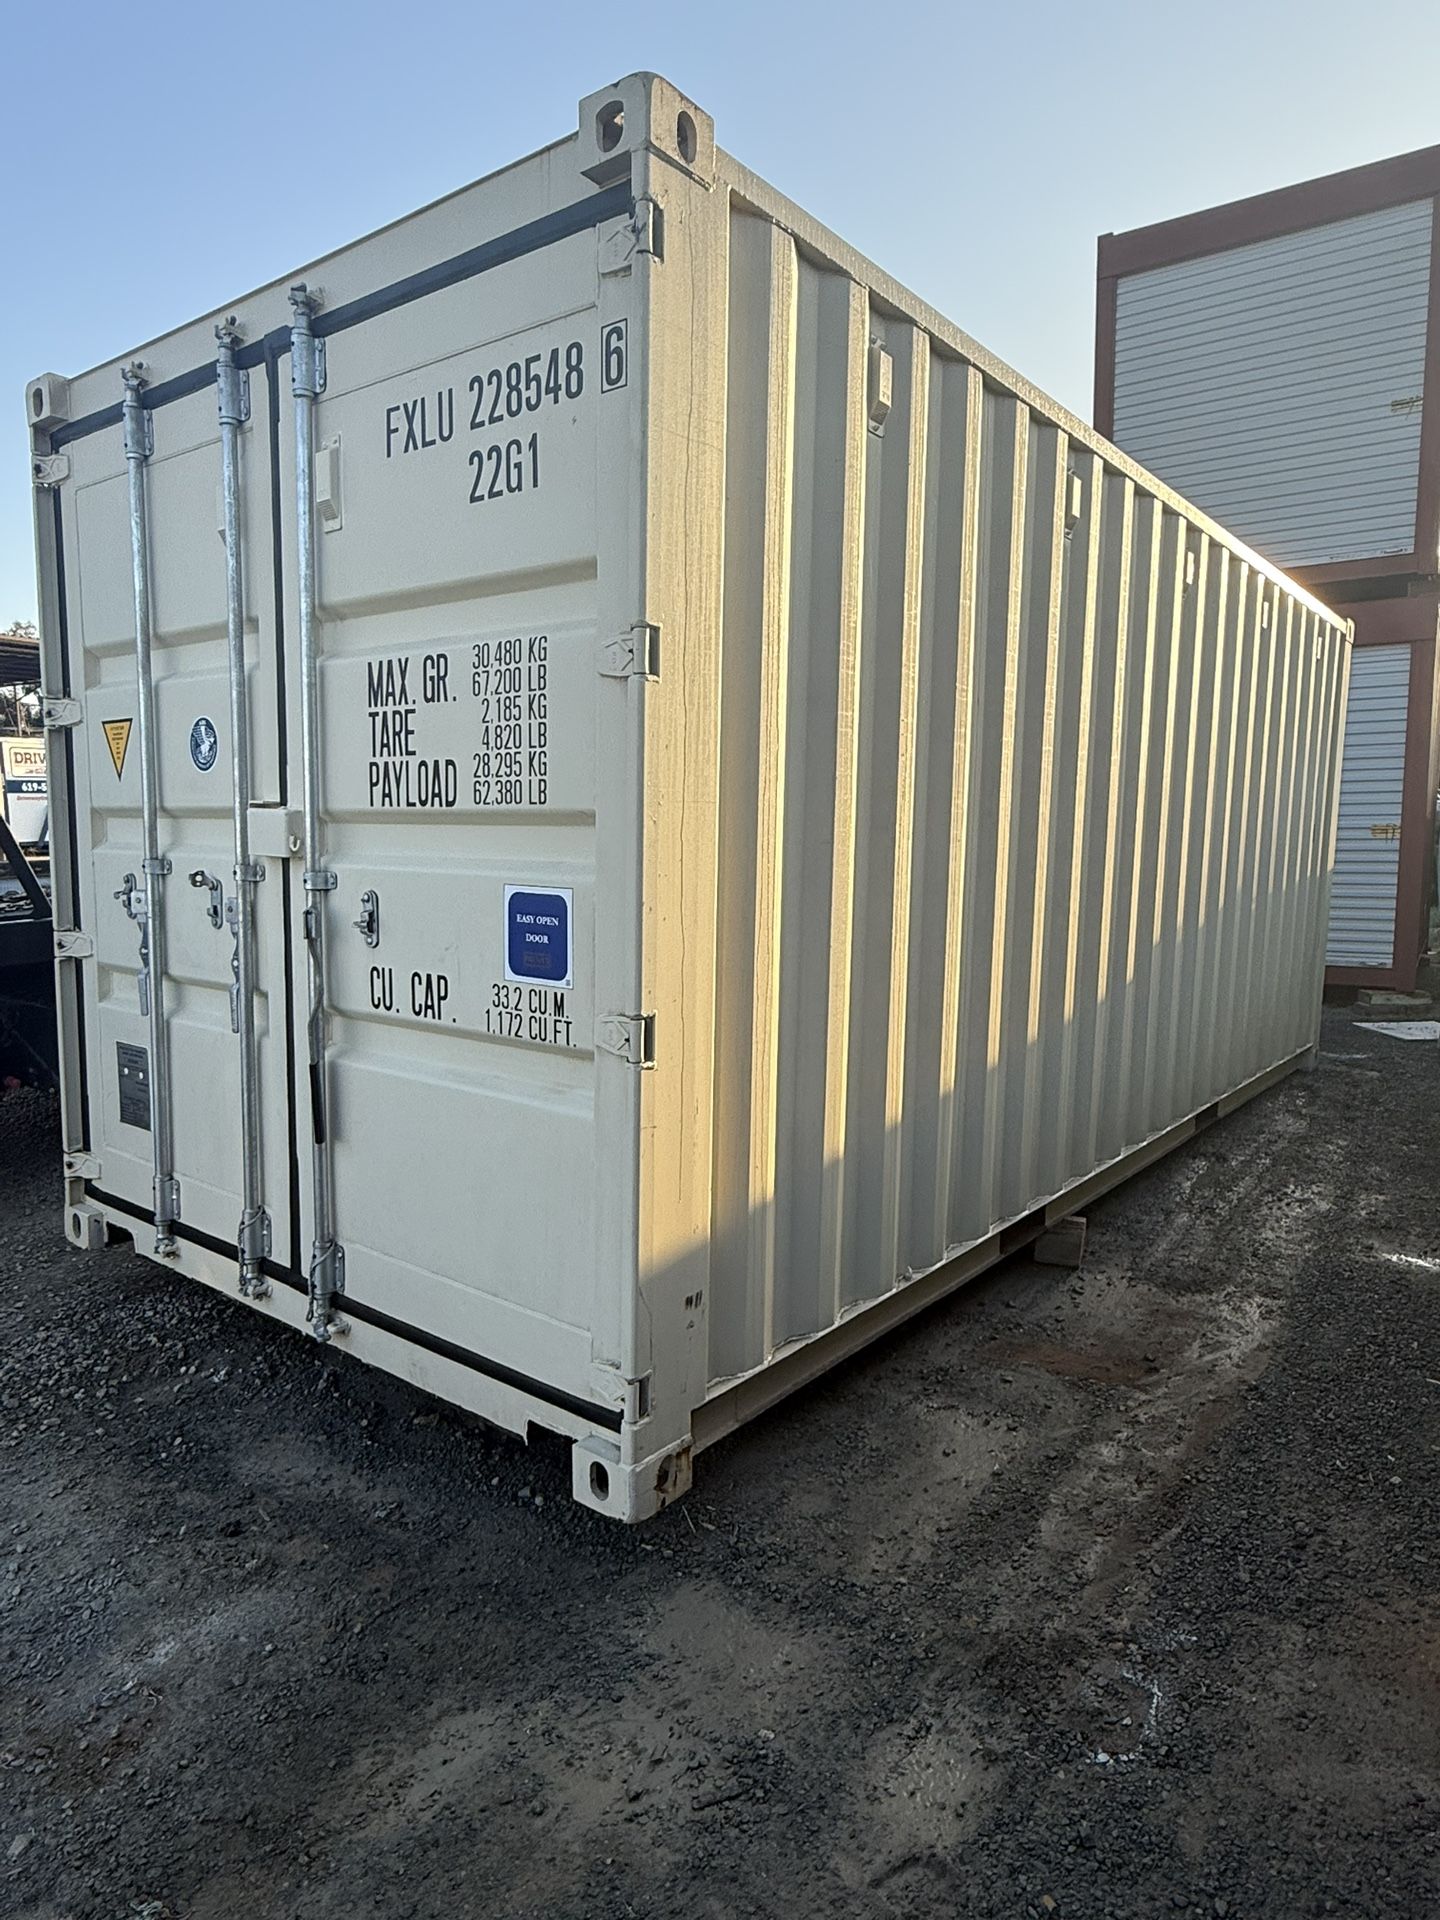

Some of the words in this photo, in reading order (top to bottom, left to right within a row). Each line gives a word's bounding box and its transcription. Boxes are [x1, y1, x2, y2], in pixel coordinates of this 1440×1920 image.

[386, 387, 454, 458] FXLU
[468, 341, 584, 431] 228548
[604, 325, 625, 387] 6
[468, 432, 539, 504] 22G1
[472, 638, 522, 669] 30,480
[528, 635, 548, 663] KG
[367, 657, 417, 708] MAX.
[422, 653, 457, 704] GR.
[472, 667, 522, 696] 67,200
[528, 664, 547, 693] LB
[481, 695, 522, 724] 2,185
[528, 693, 548, 721] KG
[368, 708, 417, 758] TARE
[481, 723, 522, 751] 4,820
[528, 722, 548, 749] LB
[473, 752, 522, 779] 28,295
[528, 750, 548, 777] KG
[369, 759, 458, 808] PAYLOAD
[473, 779, 523, 806] 62,380
[528, 778, 548, 805] LB
[516, 914, 535, 924] EASY
[536, 916, 559, 926] OPEN
[525, 933, 549, 944] DOOR
[370, 966, 400, 1014] CU.
[411, 971, 457, 1023] CAP.
[491, 983, 523, 1011] 33.2
